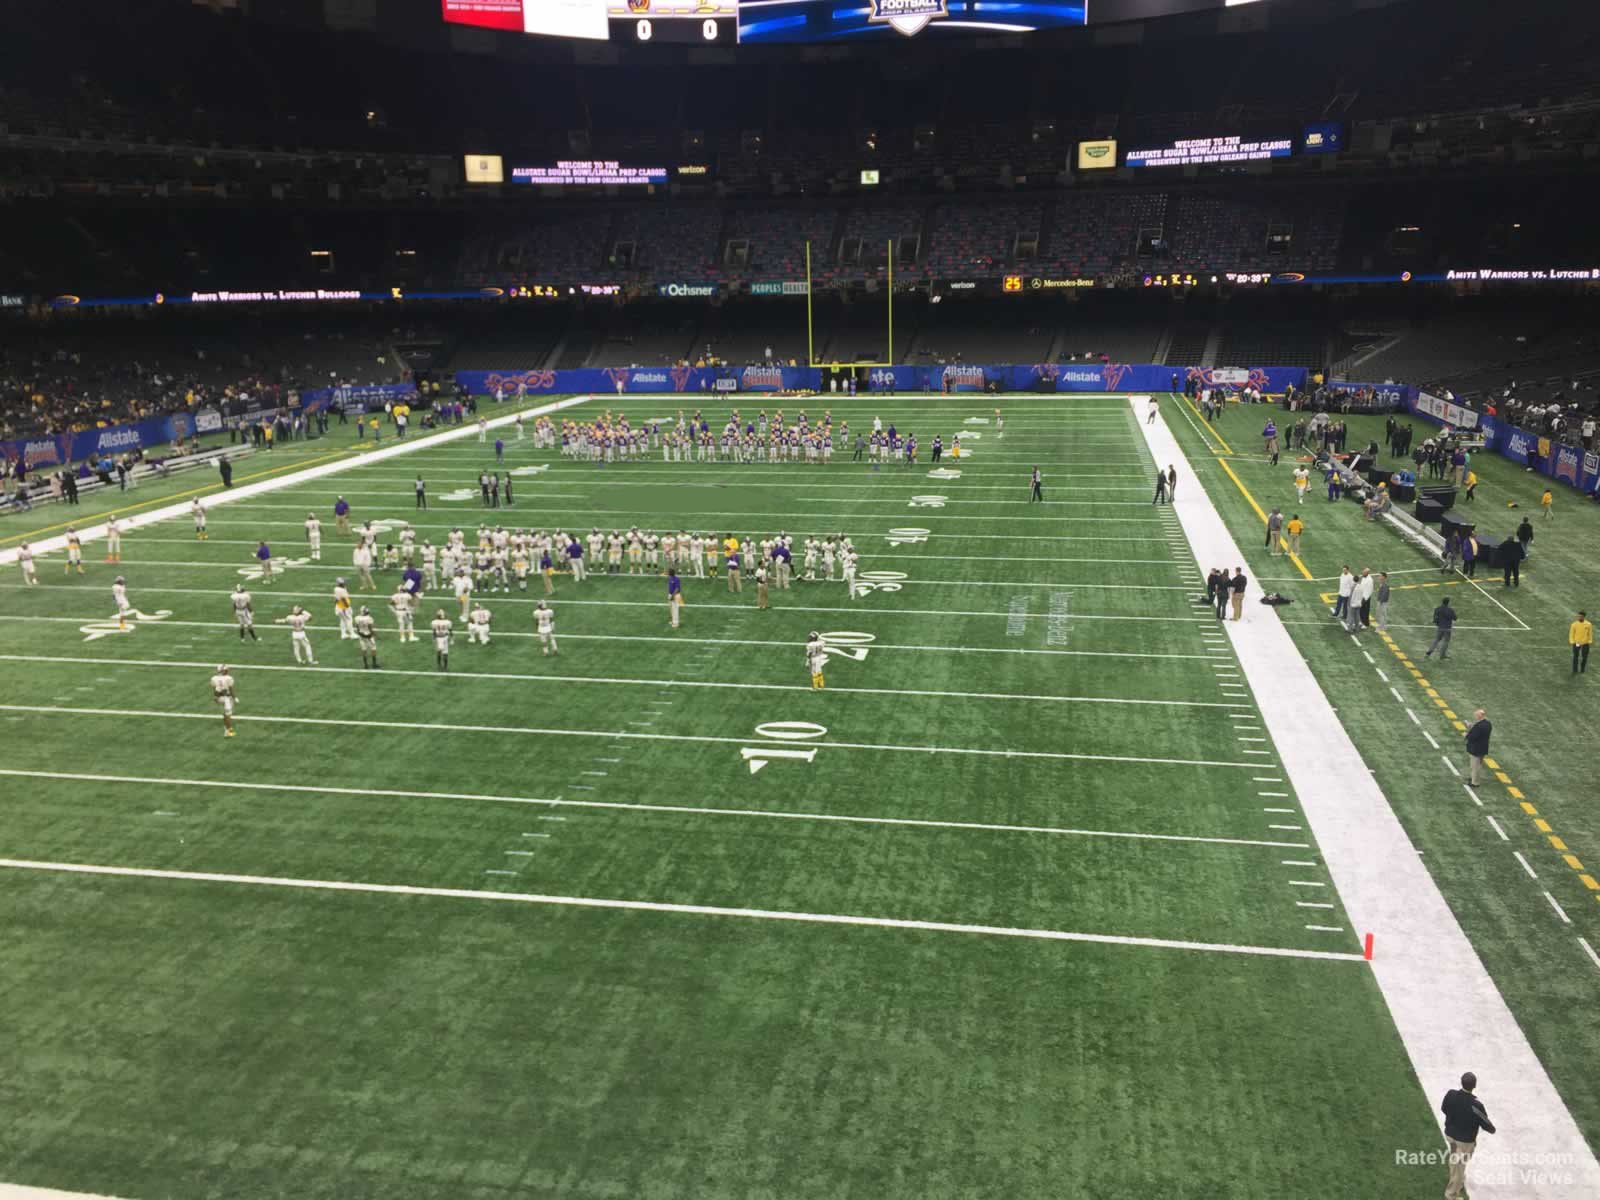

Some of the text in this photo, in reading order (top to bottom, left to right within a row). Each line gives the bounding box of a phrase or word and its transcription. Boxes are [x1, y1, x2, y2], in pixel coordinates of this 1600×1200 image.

[637, 20, 651, 40] 0
[703, 20, 718, 40] 0
[1174, 136, 1241, 148] WELCOME TO THE
[1126, 150, 1162, 160] ALLSTATE
[1163, 148, 1188, 158] SUGAR
[1240, 143, 1260, 152] PREP
[1261, 140, 1292, 150] CLASSIC
[951, 281, 975, 289] verizon
[1005, 277, 1021, 289] 25
[1043, 278, 1094, 288] Mercedes-Benz
[668, 284, 713, 296] Ochsner
[743, 366, 782, 376] Allstate
[943, 365, 983, 376] Allstate
[632, 373, 667, 383] Allstate
[1063, 372, 1100, 382] Allstate
[98, 429, 140, 449] Allstate
[740, 721, 828, 763] 10
